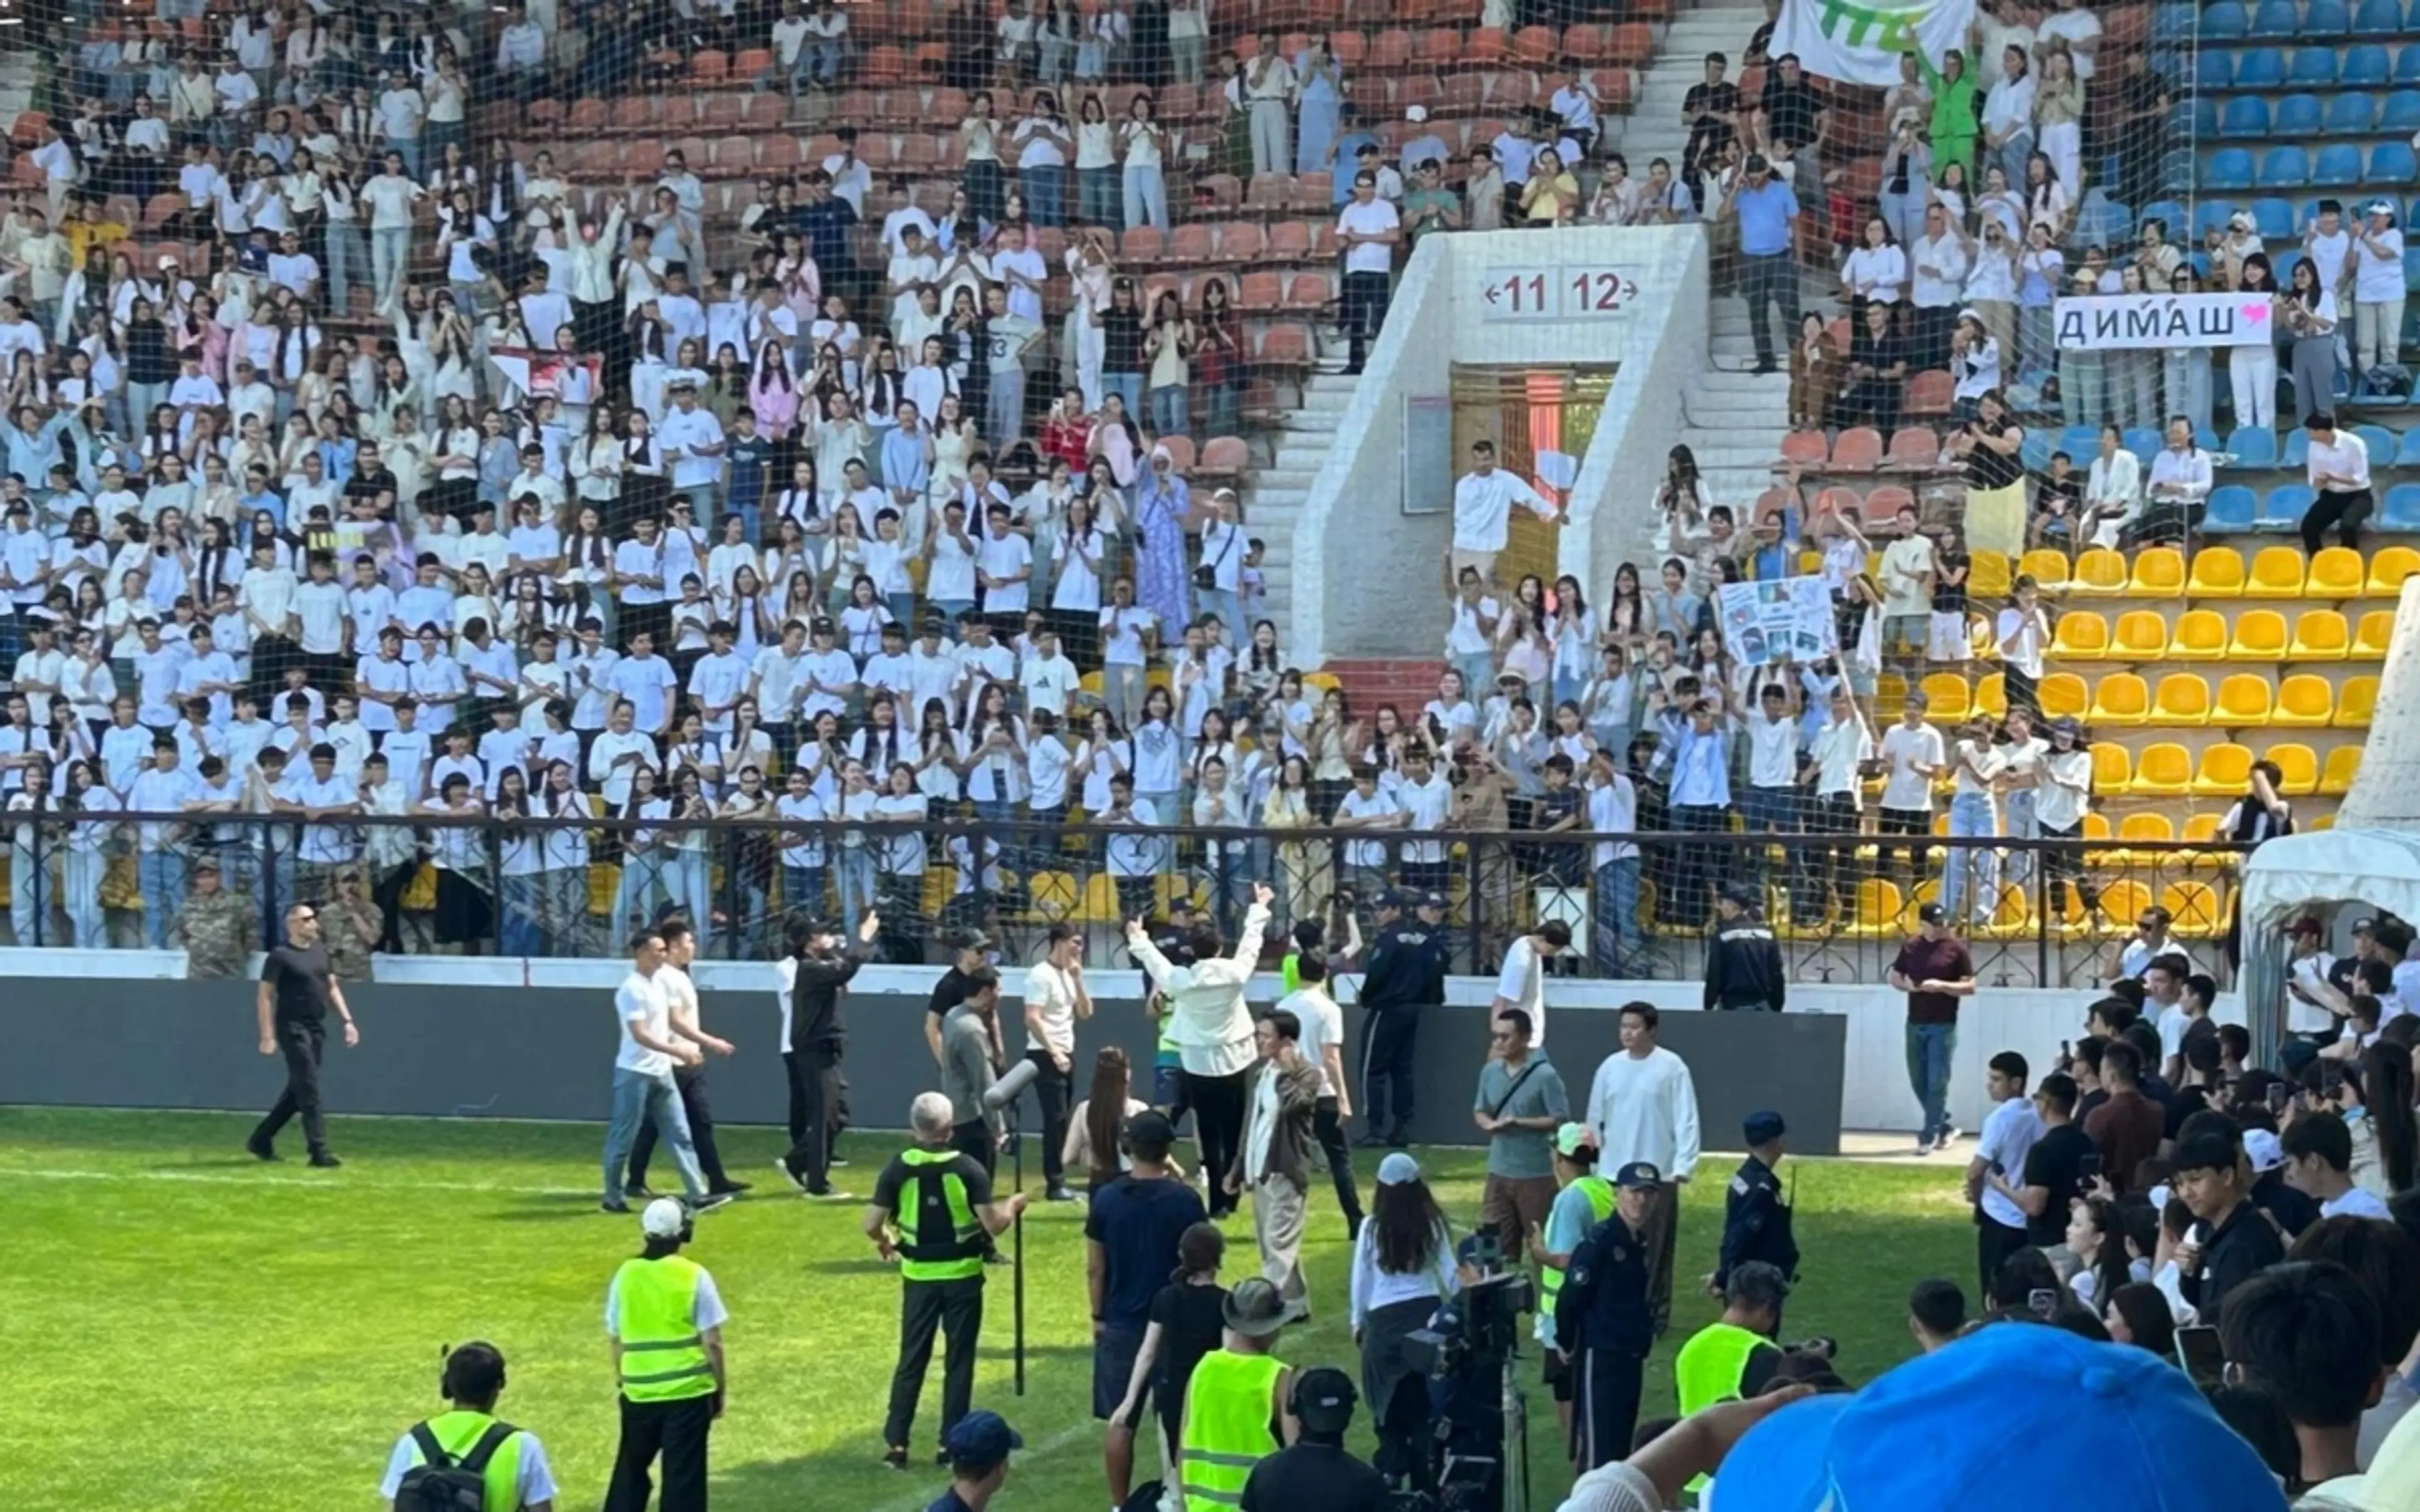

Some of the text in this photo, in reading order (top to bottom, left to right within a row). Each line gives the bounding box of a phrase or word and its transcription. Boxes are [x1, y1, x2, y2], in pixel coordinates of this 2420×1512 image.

[1504, 272, 1620, 312] 11 12
[2058, 305, 2234, 345] ДИМАШ
